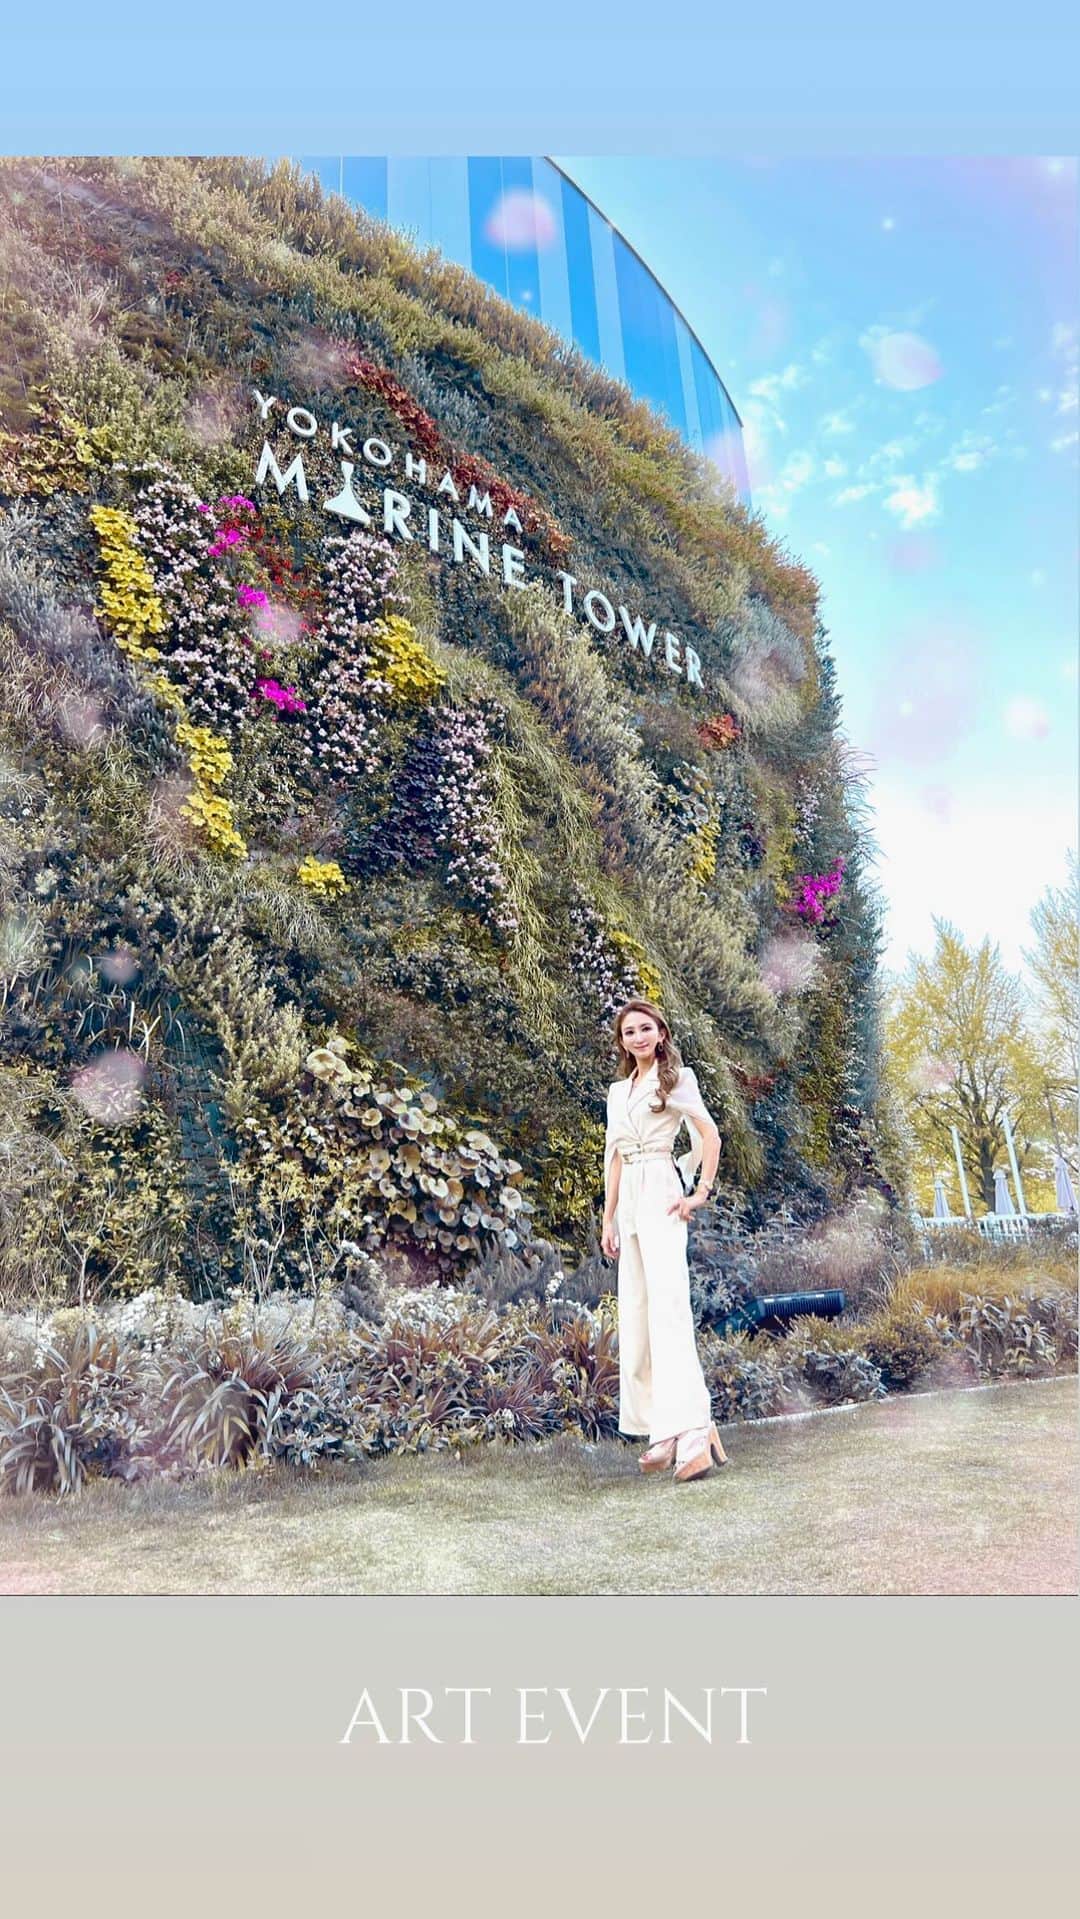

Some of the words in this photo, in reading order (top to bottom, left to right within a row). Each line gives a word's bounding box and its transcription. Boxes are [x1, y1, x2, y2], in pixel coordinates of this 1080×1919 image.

[253, 389, 523, 533] YOKOHAMA
[255, 440, 528, 590] MARINE
[556, 570, 705, 689] TOWER
